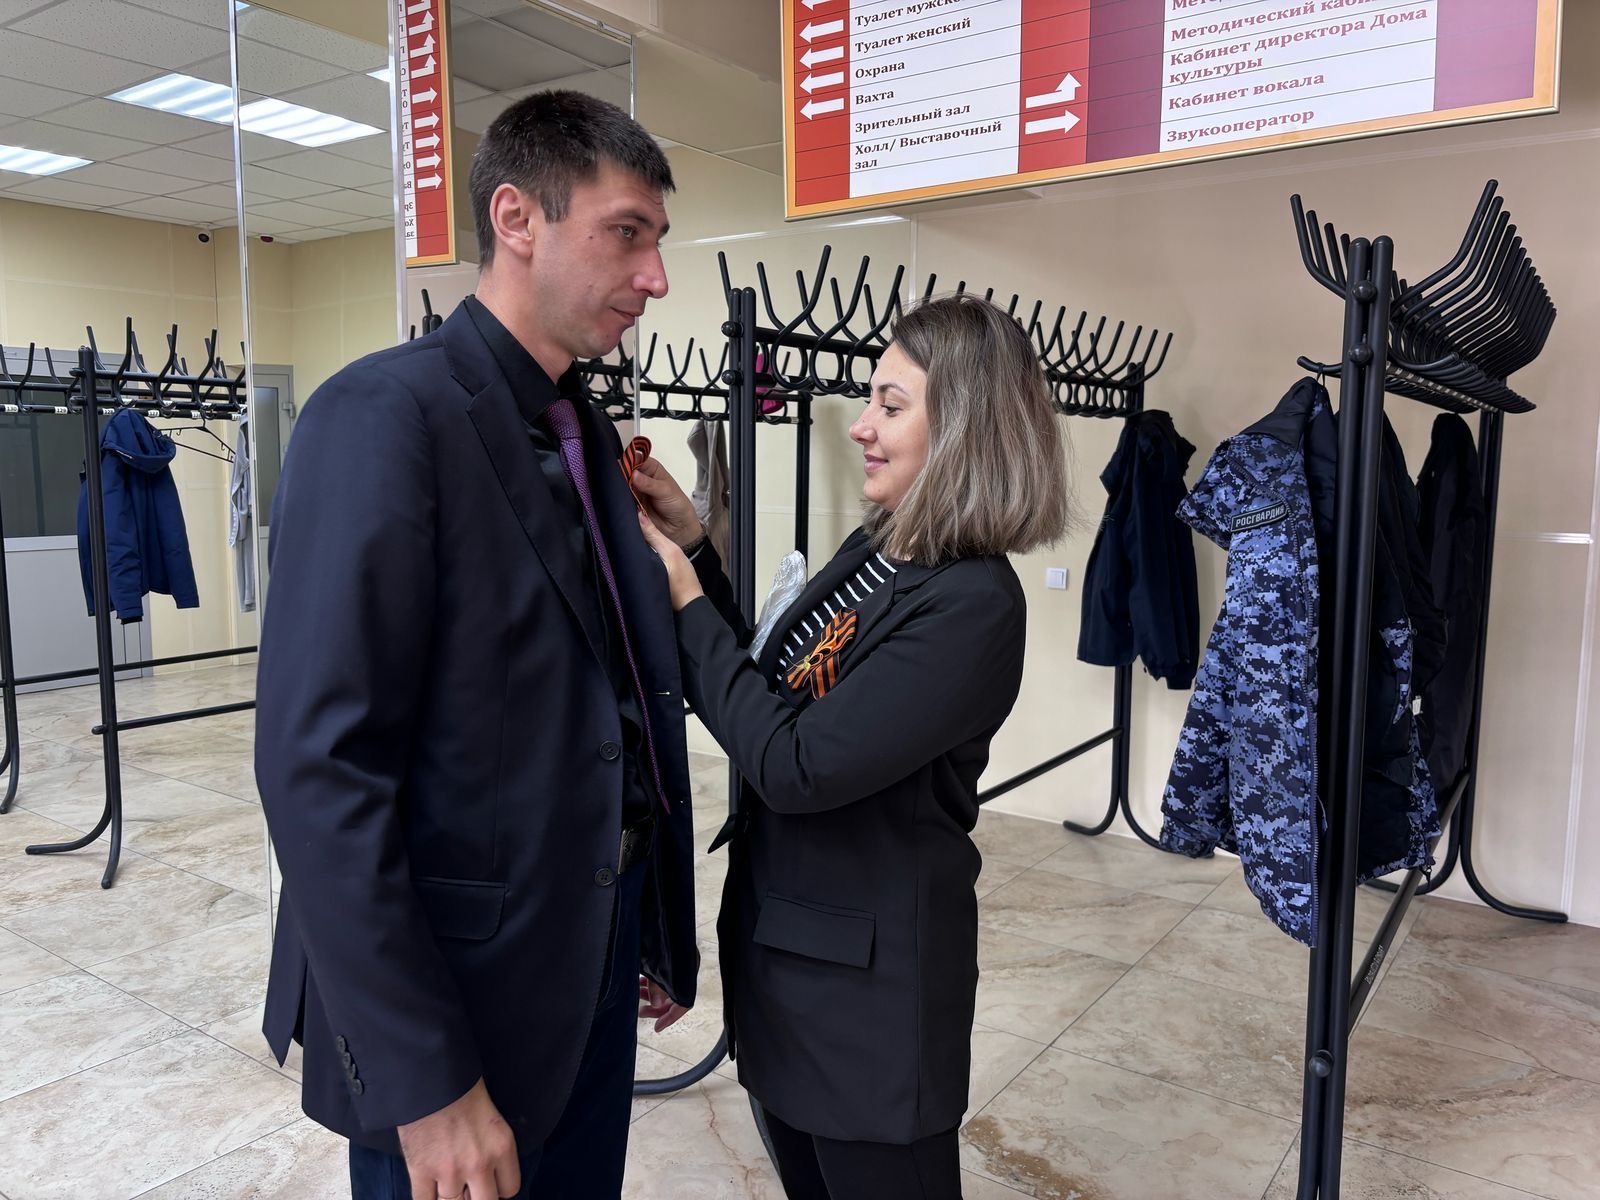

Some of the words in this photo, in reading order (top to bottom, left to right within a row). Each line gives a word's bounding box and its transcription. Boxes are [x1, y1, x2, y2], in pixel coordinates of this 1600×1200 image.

[855, 7, 904, 27] Туалет
[906, 0, 960, 15] мужск
[1170, 2, 1316, 42] Методический
[855, 35, 904, 53] Туалет
[906, 17, 972, 42] женский
[1170, 40, 1250, 66] Кабинет
[1255, 20, 1366, 53] директора
[1370, 7, 1428, 31] Дома
[855, 62, 905, 79] Охрана
[1169, 55, 1263, 84] культуры
[855, 89, 895, 105] Вахта
[1168, 84, 1248, 110] Кабинет
[1252, 73, 1325, 96] вокала
[855, 109, 943, 134] Зрительный
[945, 104, 971, 117] зал
[1166, 109, 1315, 143] Звукооператор
[855, 138, 896, 155] Холл/
[900, 122, 1002, 148] Выставочный
[855, 158, 878, 170] зал
